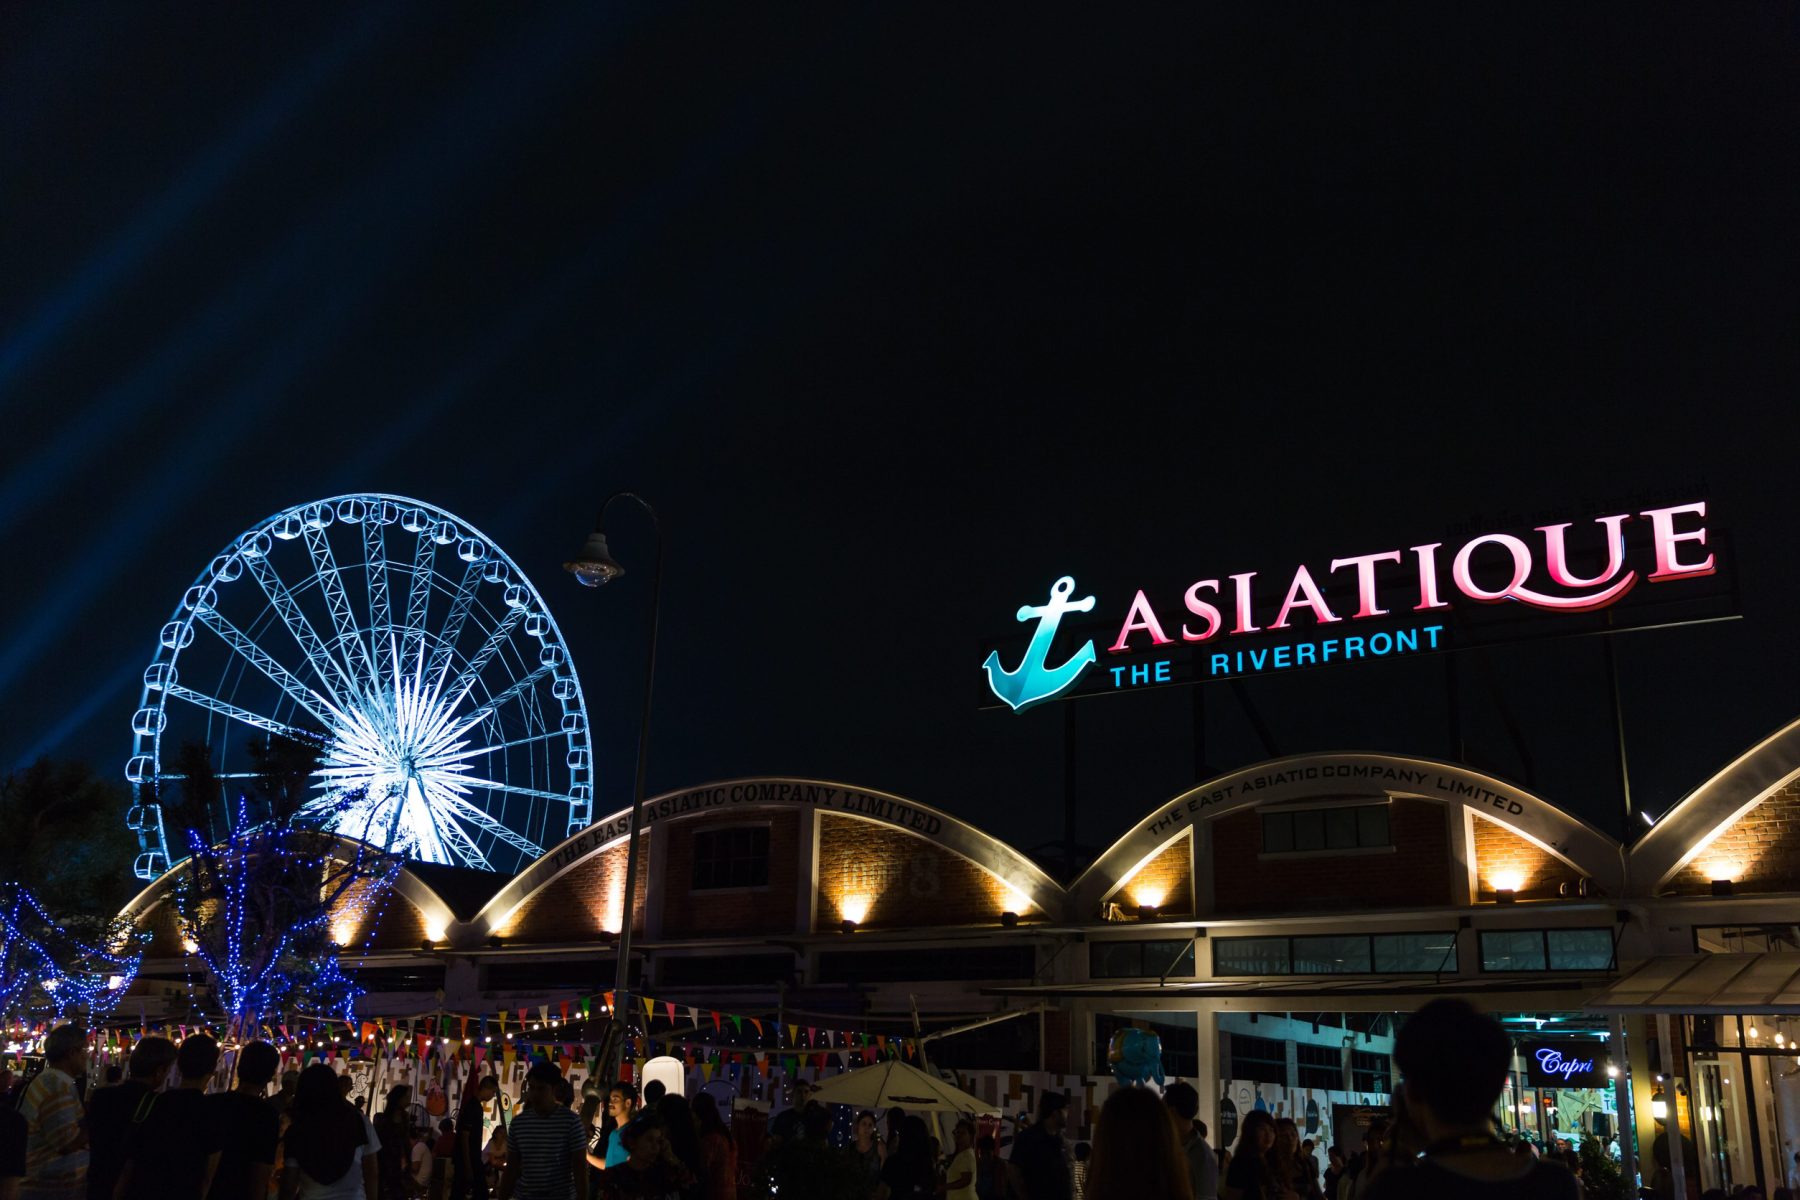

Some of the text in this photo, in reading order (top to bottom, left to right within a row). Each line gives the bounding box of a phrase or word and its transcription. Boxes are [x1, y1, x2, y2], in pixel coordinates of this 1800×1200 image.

[1107, 501, 1716, 653] ASIATIQUE
[1110, 625, 1443, 688] THE RIVERFRONT
[551, 783, 942, 869] THE EAS ASIATIC COMPANY LIMITED
[1148, 765, 1524, 836] THE EAST ASIATIC COMPANY LIMITED
[1535, 1048, 1594, 1081] Capri
